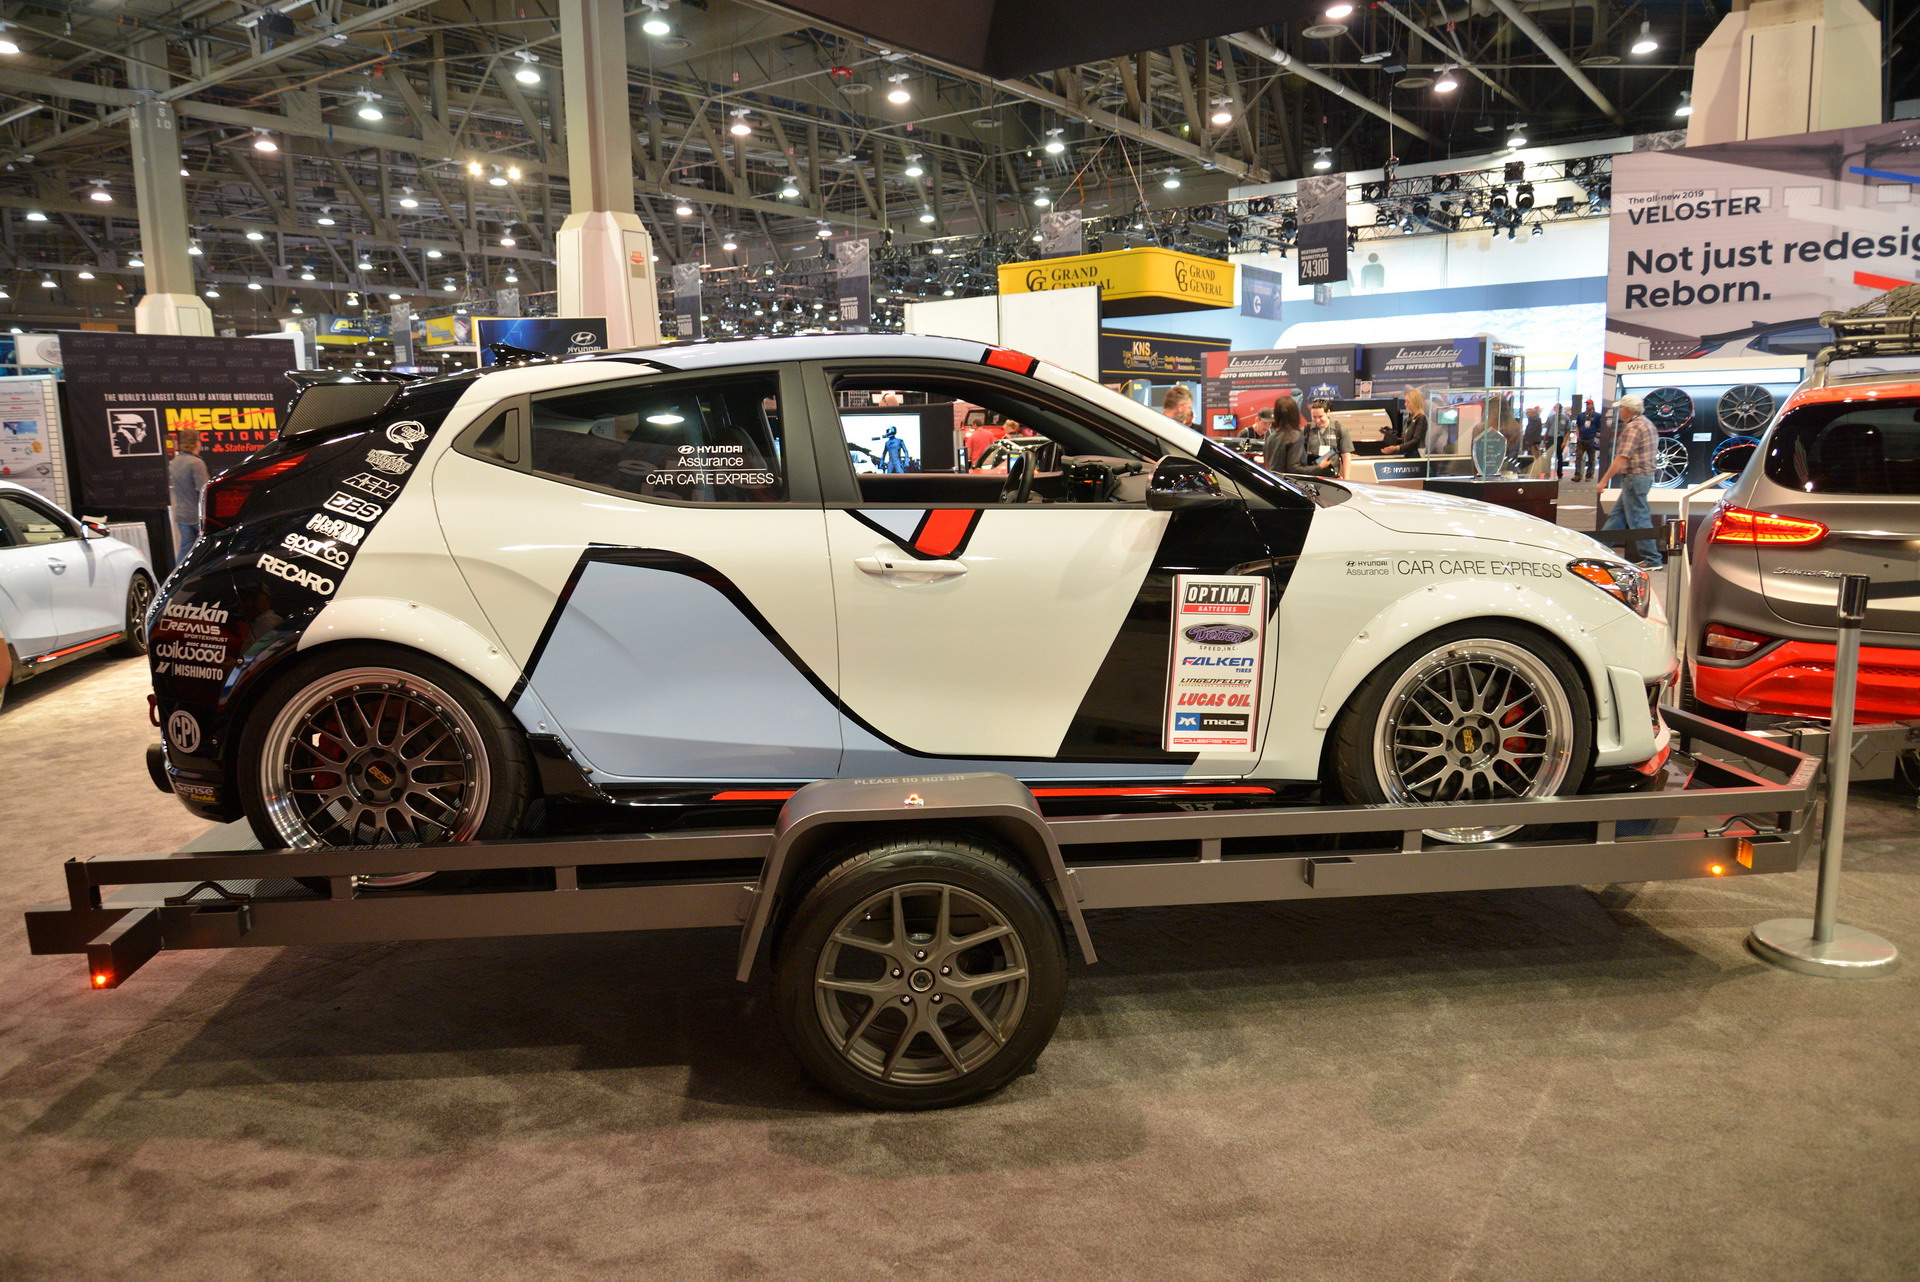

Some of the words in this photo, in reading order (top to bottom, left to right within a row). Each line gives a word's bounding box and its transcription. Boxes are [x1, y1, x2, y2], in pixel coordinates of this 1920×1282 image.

[1628, 196, 1645, 205] The
[1647, 193, 1681, 204] all-new
[1682, 189, 1704, 200] 2019
[1628, 196, 1762, 225] VELOSTER
[1627, 247, 1693, 276] Not
[1701, 241, 1773, 276] just
[1051, 266, 1098, 281] GRAND
[1189, 265, 1216, 281] GRAND
[1301, 258, 1330, 279] 24300
[1189, 280, 1224, 297] GENERAL
[1625, 280, 1772, 310] Reborn.
[1133, 341, 1151, 356] KNS
[1396, 346, 1462, 360] Legendary
[1229, 356, 1287, 368] Legendary
[1627, 362, 1665, 371] WHEELS
[104, 393, 117, 401] THE
[118, 393, 147, 401] WORLD'S
[148, 393, 175, 401] LARGEST
[176, 393, 198, 401] SELLER
[199, 393, 207, 401] OF
[207, 393, 233, 401] ANTIQUE
[233, 393, 274, 401] MOTORCYCLES
[165, 408, 278, 431] MECUM
[697, 445, 743, 453] HYUNDAI
[369, 450, 411, 469] INTERSTATE
[678, 456, 744, 467] Assurance
[646, 474, 674, 485] CAR
[677, 473, 714, 485] CARE
[716, 472, 775, 485] EXPRESS
[285, 532, 350, 566] sparco
[256, 553, 335, 596] RECARO
[1346, 567, 1390, 576] Assurance
[1397, 560, 1434, 575] CAR
[1439, 560, 1487, 575] CARE
[1490, 560, 1563, 578] EXPRESS
[1186, 585, 1250, 603] OPTIMA
[163, 598, 229, 624] katzkin
[167, 621, 222, 636] REMUS
[156, 640, 227, 664] wilwood
[200, 641, 223, 650] BRAKES
[1182, 656, 1254, 667] FALKEN
[174, 663, 223, 681] MISHIMOTO
[1177, 693, 1227, 707] LUCAS
[1227, 694, 1251, 707] OIL
[368, 765, 393, 785] BBS
[854, 777, 899, 785] PLEASE
